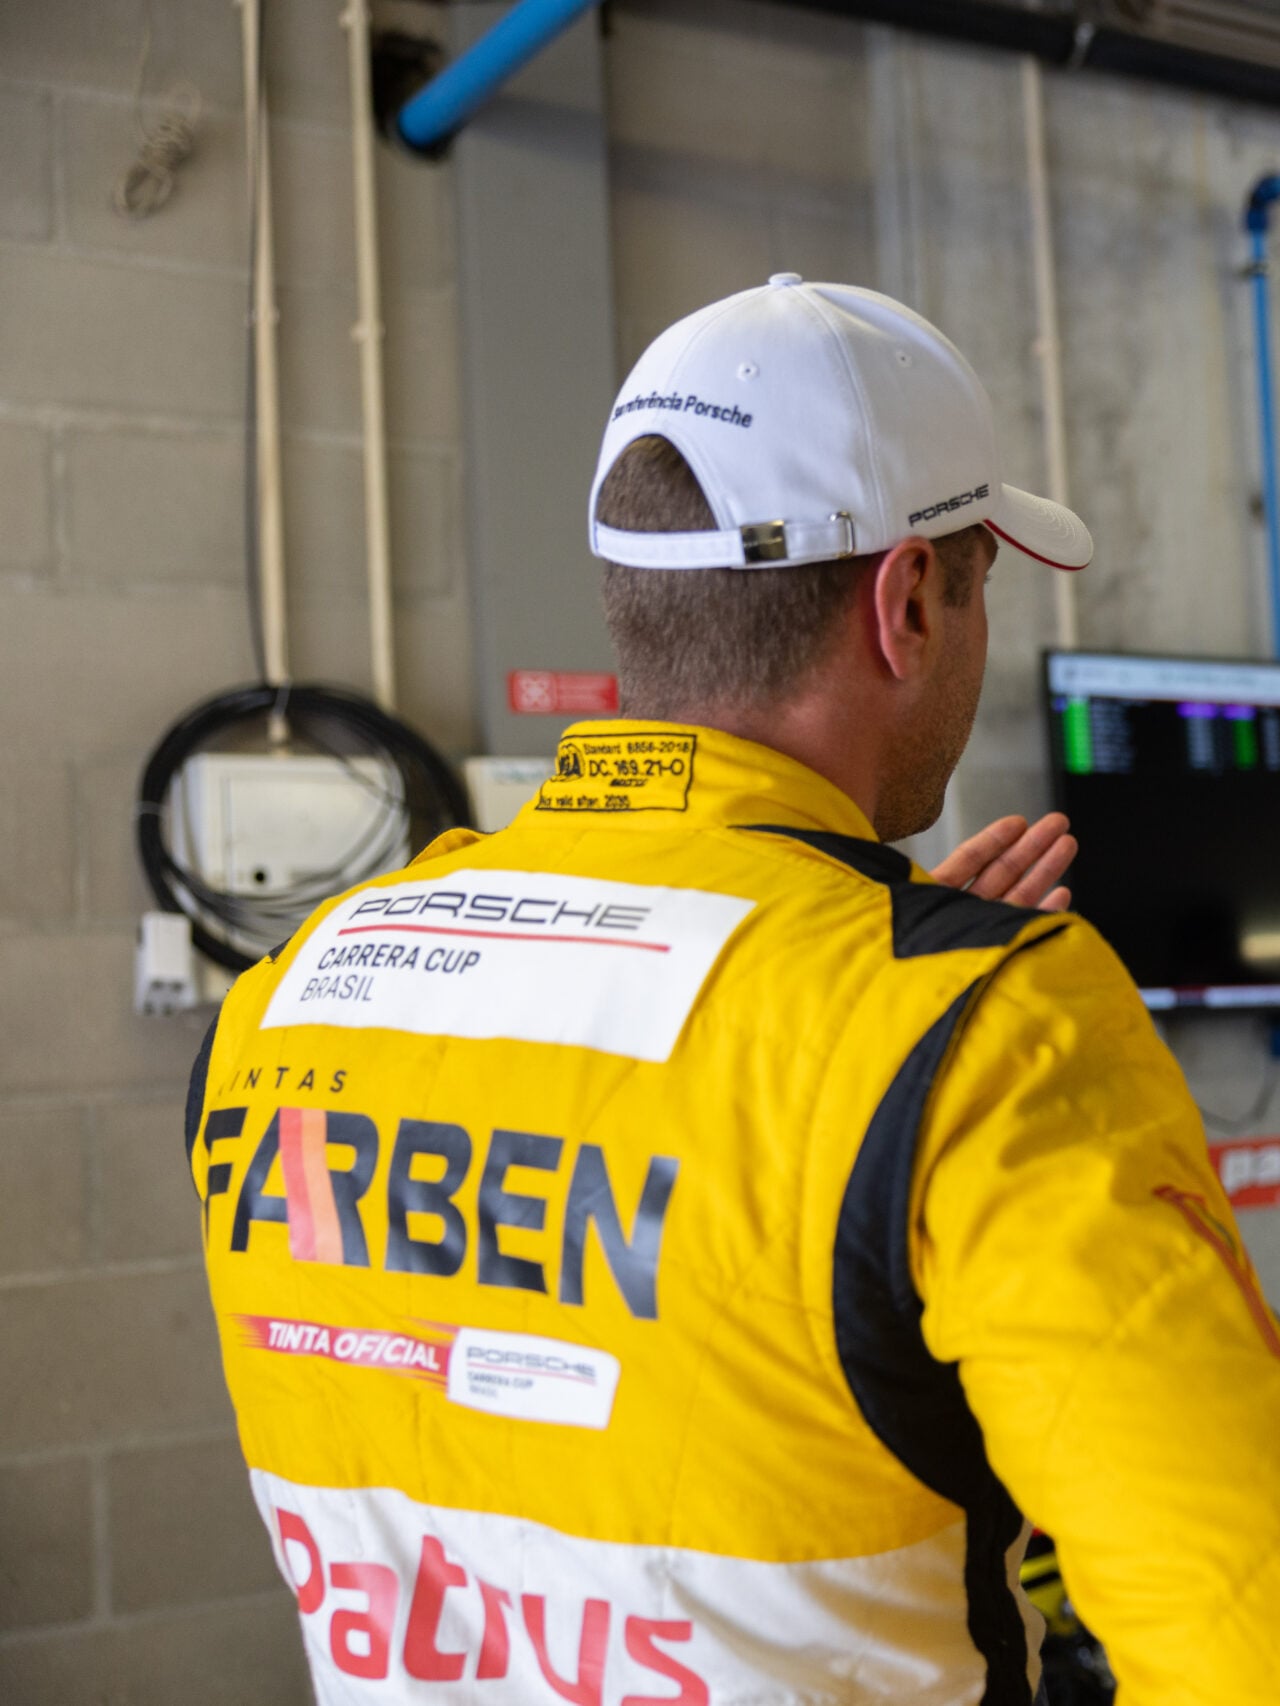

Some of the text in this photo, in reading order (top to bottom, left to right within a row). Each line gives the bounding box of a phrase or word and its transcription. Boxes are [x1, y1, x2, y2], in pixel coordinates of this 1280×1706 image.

[684, 395, 752, 428] Porsche
[908, 483, 989, 528] PORSCHE
[583, 743, 621, 755] Standard
[349, 891, 651, 931] PORSCHE
[317, 943, 481, 976] CARRERA CUP
[300, 975, 374, 1003] BRASIL
[202, 1106, 681, 1321] FARBEN
[269, 1321, 441, 1372] TINTA OFICIAL
[466, 1347, 596, 1378] PORSCHE
